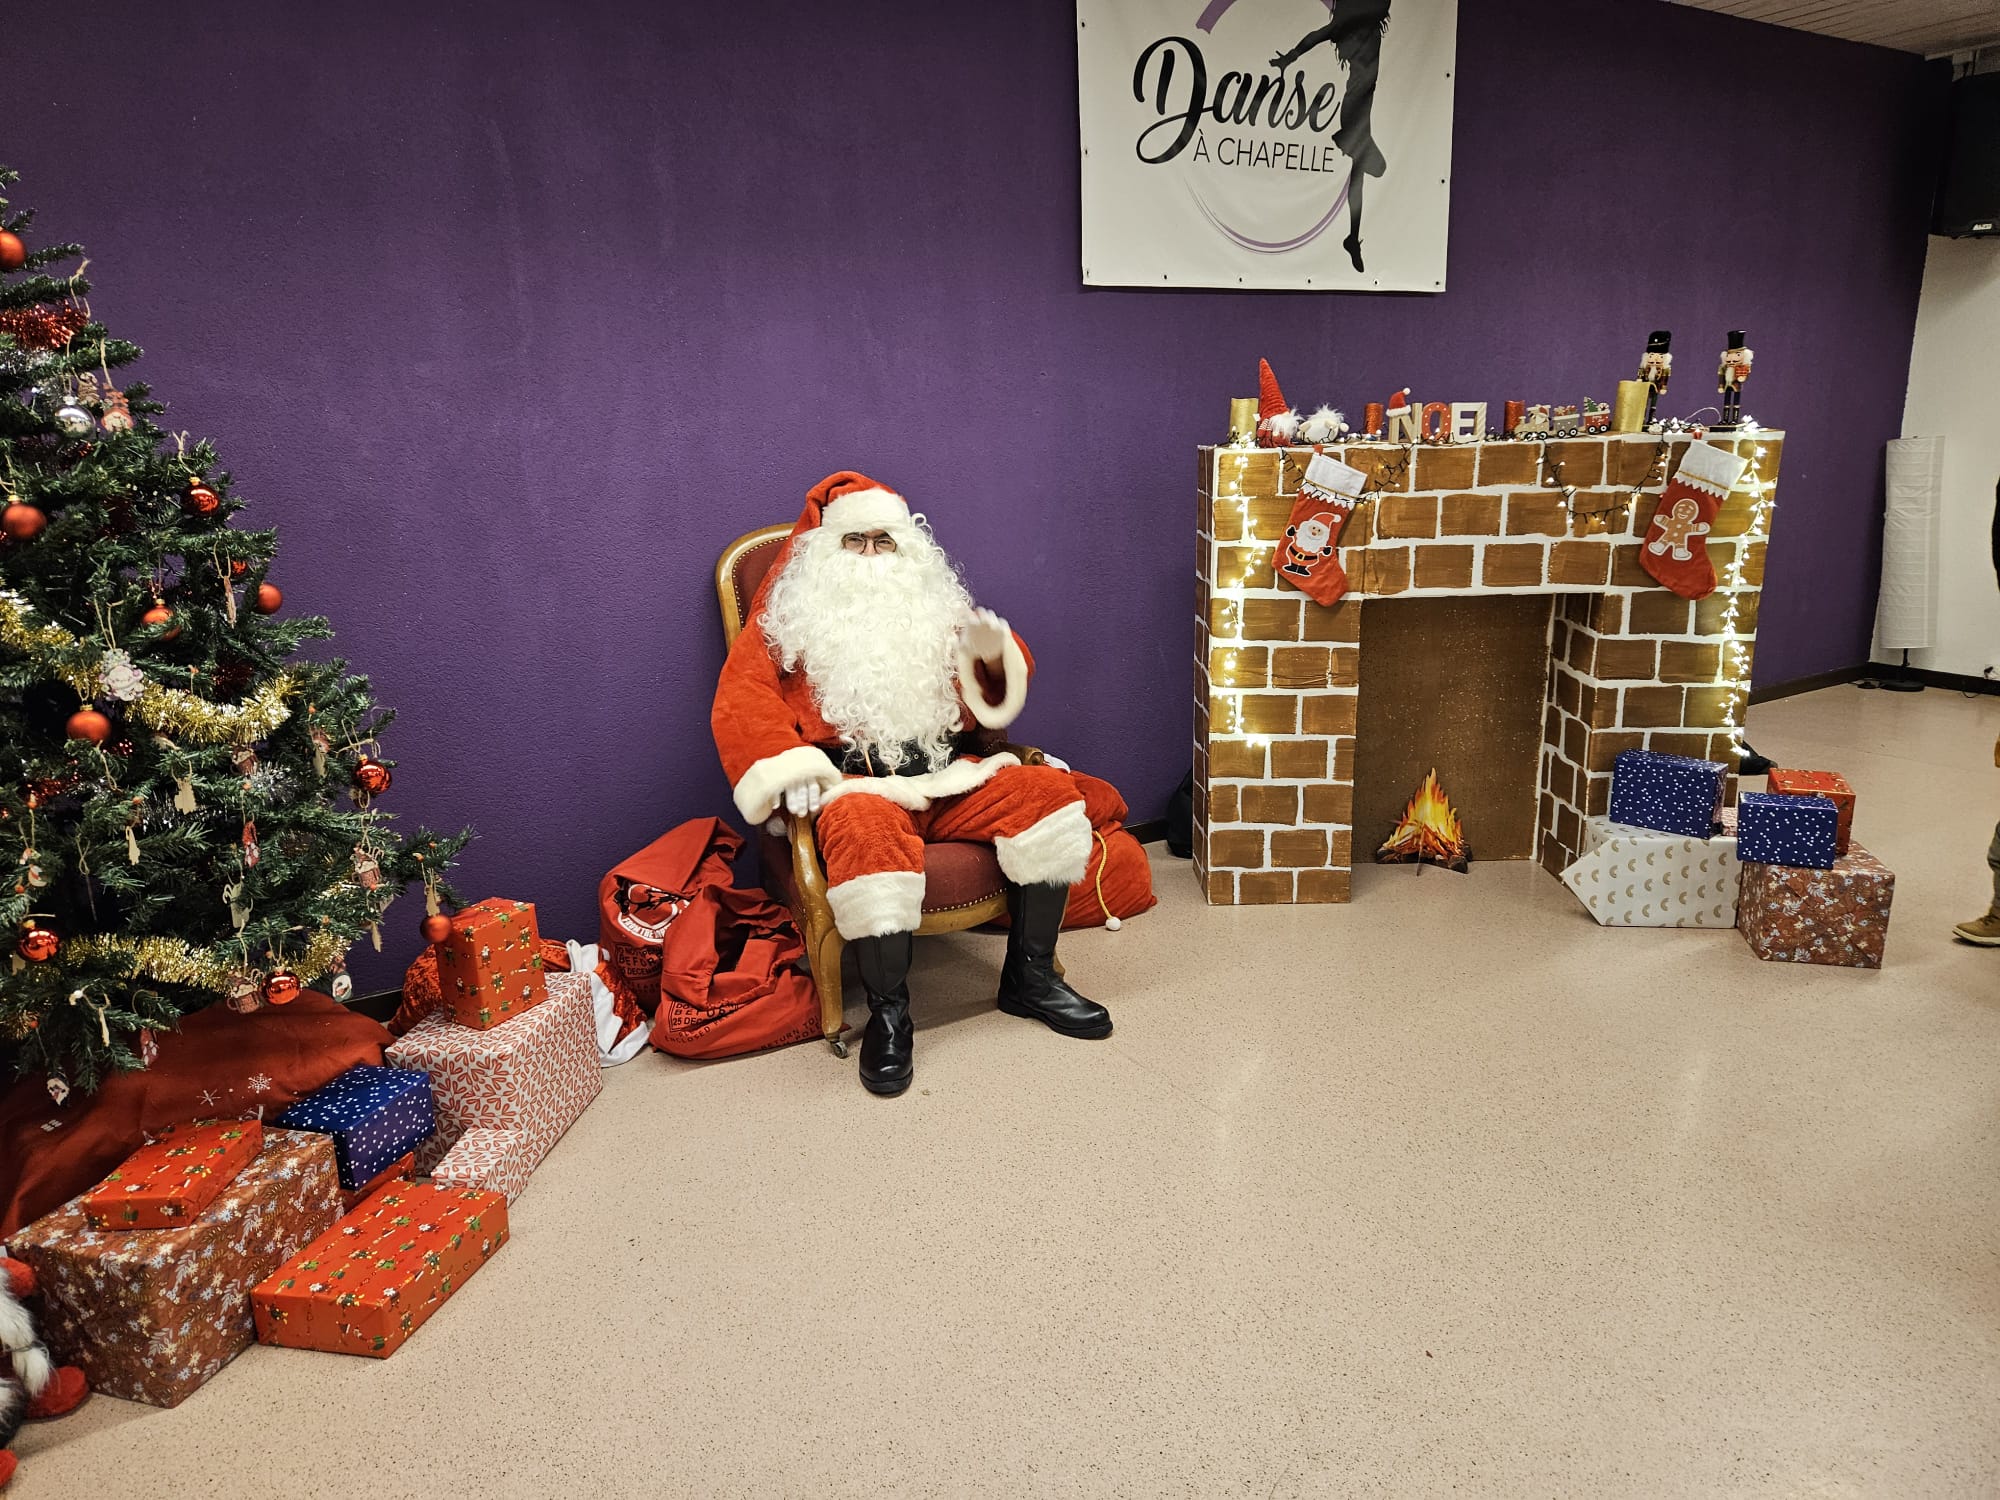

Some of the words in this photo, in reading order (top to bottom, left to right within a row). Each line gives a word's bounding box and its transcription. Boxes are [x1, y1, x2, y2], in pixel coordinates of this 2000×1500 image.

[1133, 36, 1340, 164] Danse
[1193, 129, 1210, 163] À
[1218, 137, 1334, 173] CHAPELLE
[618, 954, 658, 968] BEFOR
[672, 1018, 682, 1026] 25
